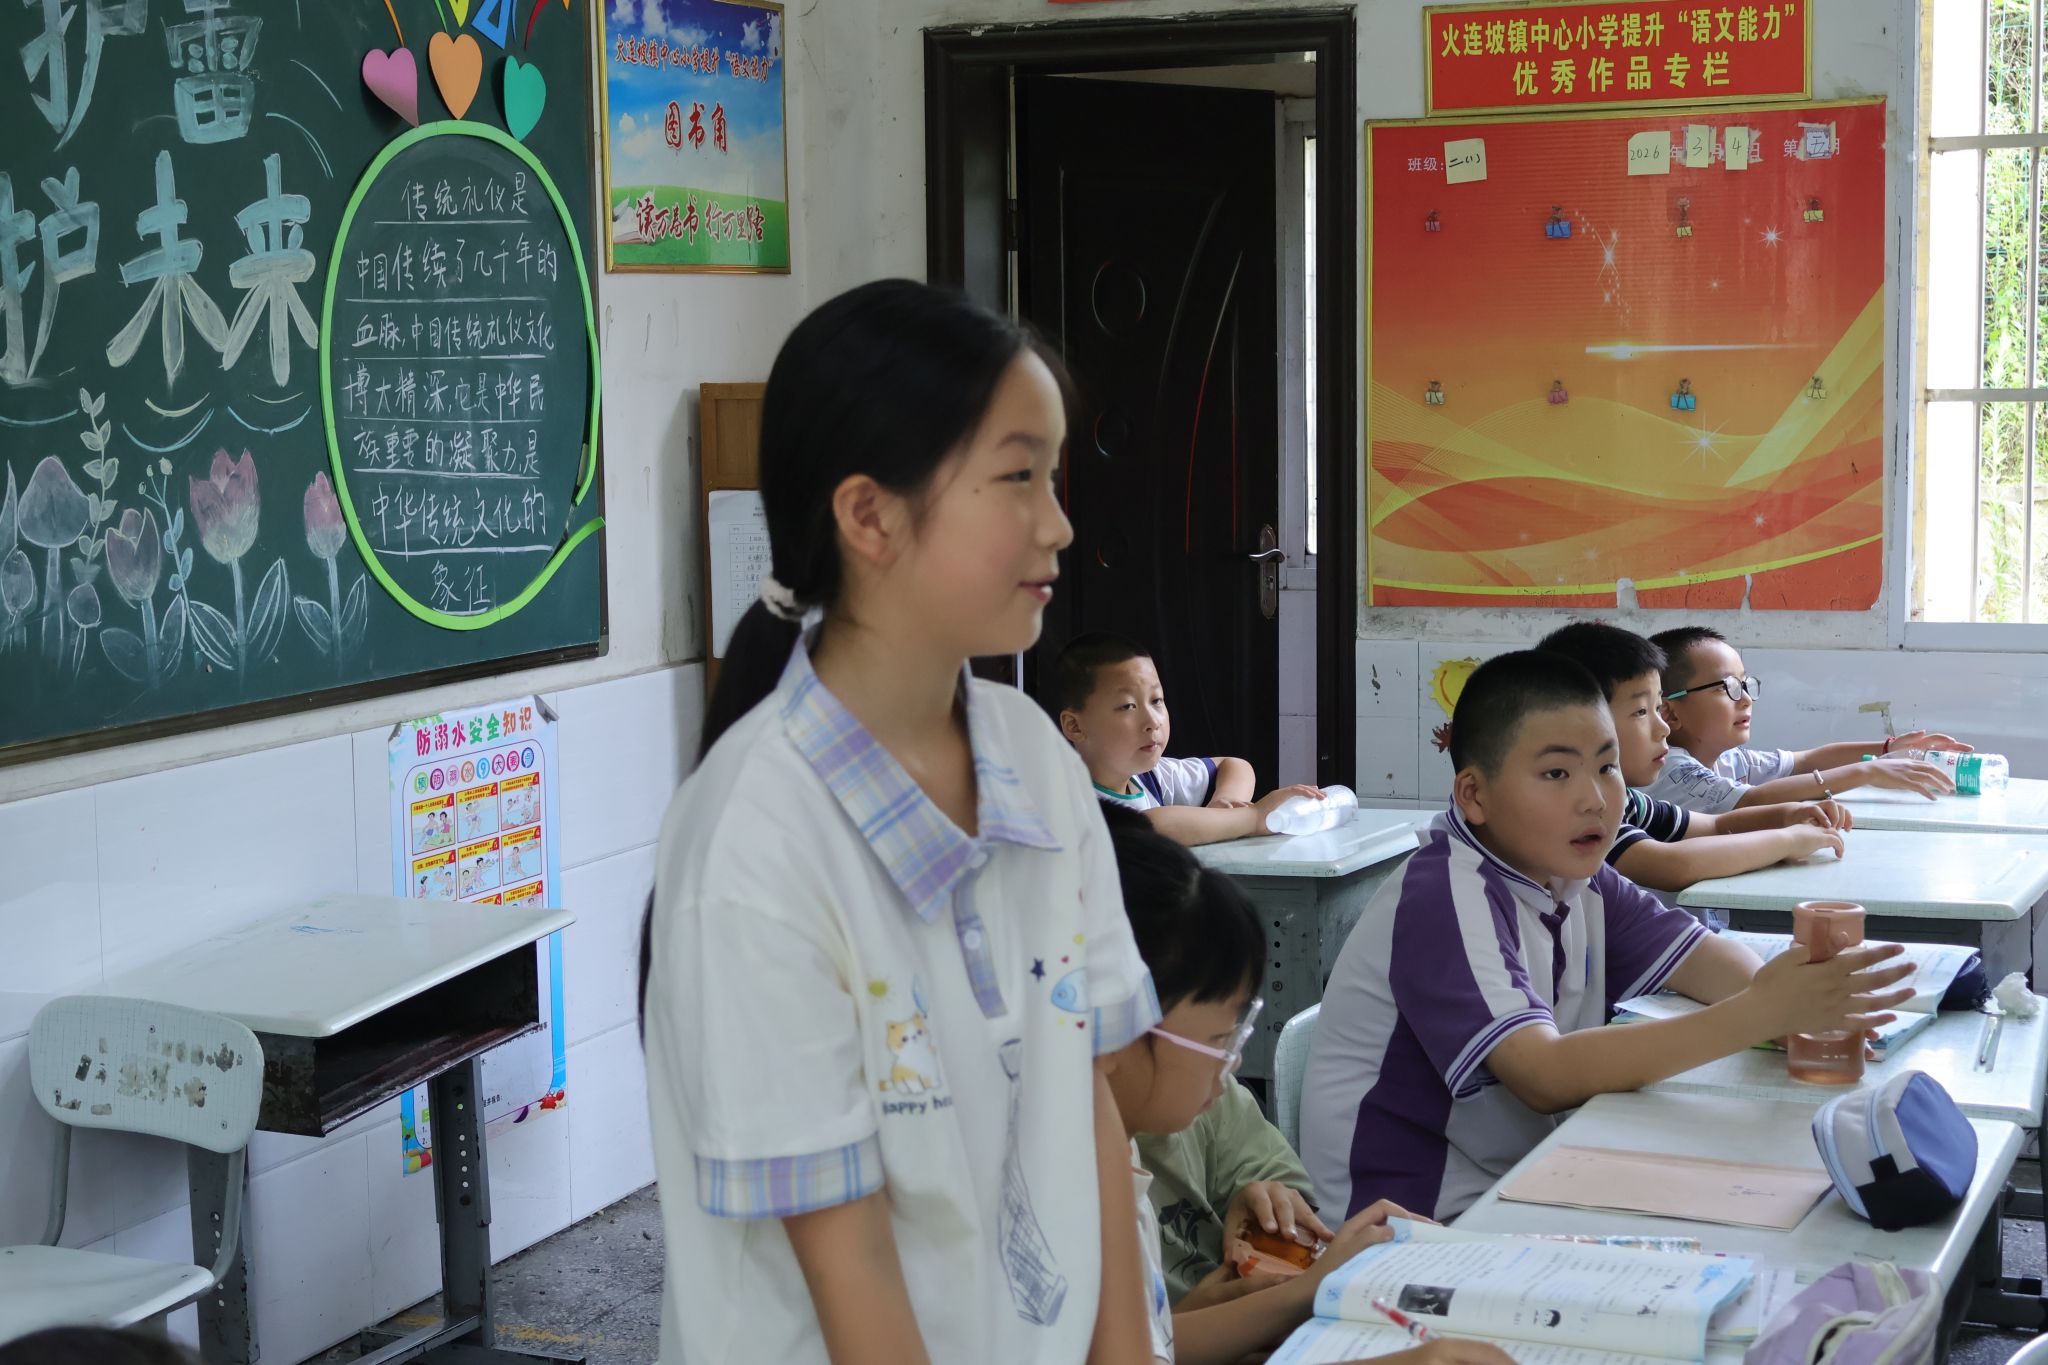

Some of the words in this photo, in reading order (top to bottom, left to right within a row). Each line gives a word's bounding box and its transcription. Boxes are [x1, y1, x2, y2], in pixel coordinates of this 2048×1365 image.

[1441, 3, 1796, 58] 火连坡镇中心小学提升“语文能力”
[1513, 51, 1731, 95] 优秀作品专栏
[664, 101, 728, 152] 图书角
[402, 172, 528, 220] 传统礼仪是
[636, 194, 699, 246] 读万卷书
[705, 202, 766, 243] 行万里路
[371, 481, 547, 562] 中华传统文化的
[431, 560, 493, 612] 象征
[416, 706, 532, 757] 防溺水安全知识
